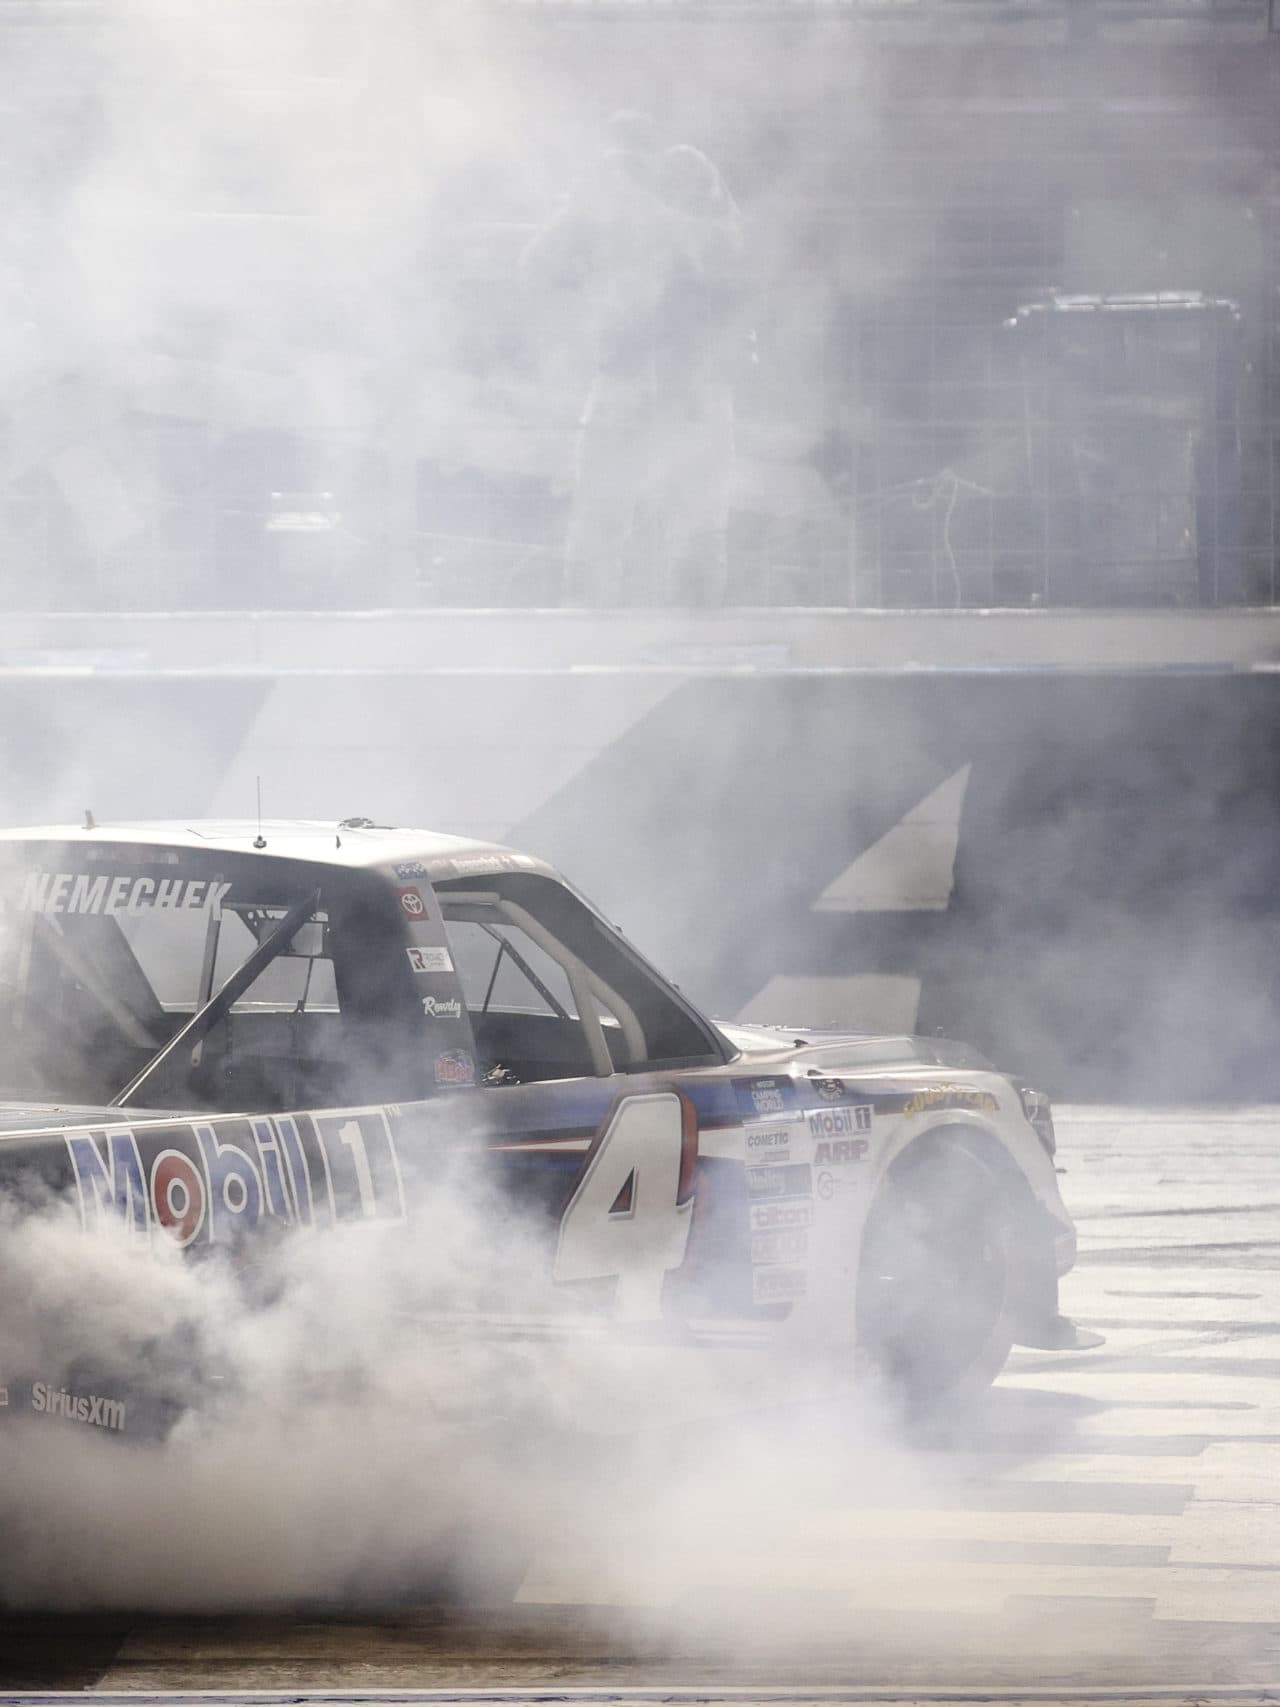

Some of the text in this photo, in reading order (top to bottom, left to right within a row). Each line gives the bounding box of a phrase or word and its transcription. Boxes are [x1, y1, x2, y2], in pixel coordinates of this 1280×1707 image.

[18, 872, 233, 921] NEMECHEK
[809, 1109, 854, 1136] Mobil
[815, 1140, 869, 1163] ARP
[64, 1115, 314, 1250] Mobil
[554, 1092, 695, 1320] 4
